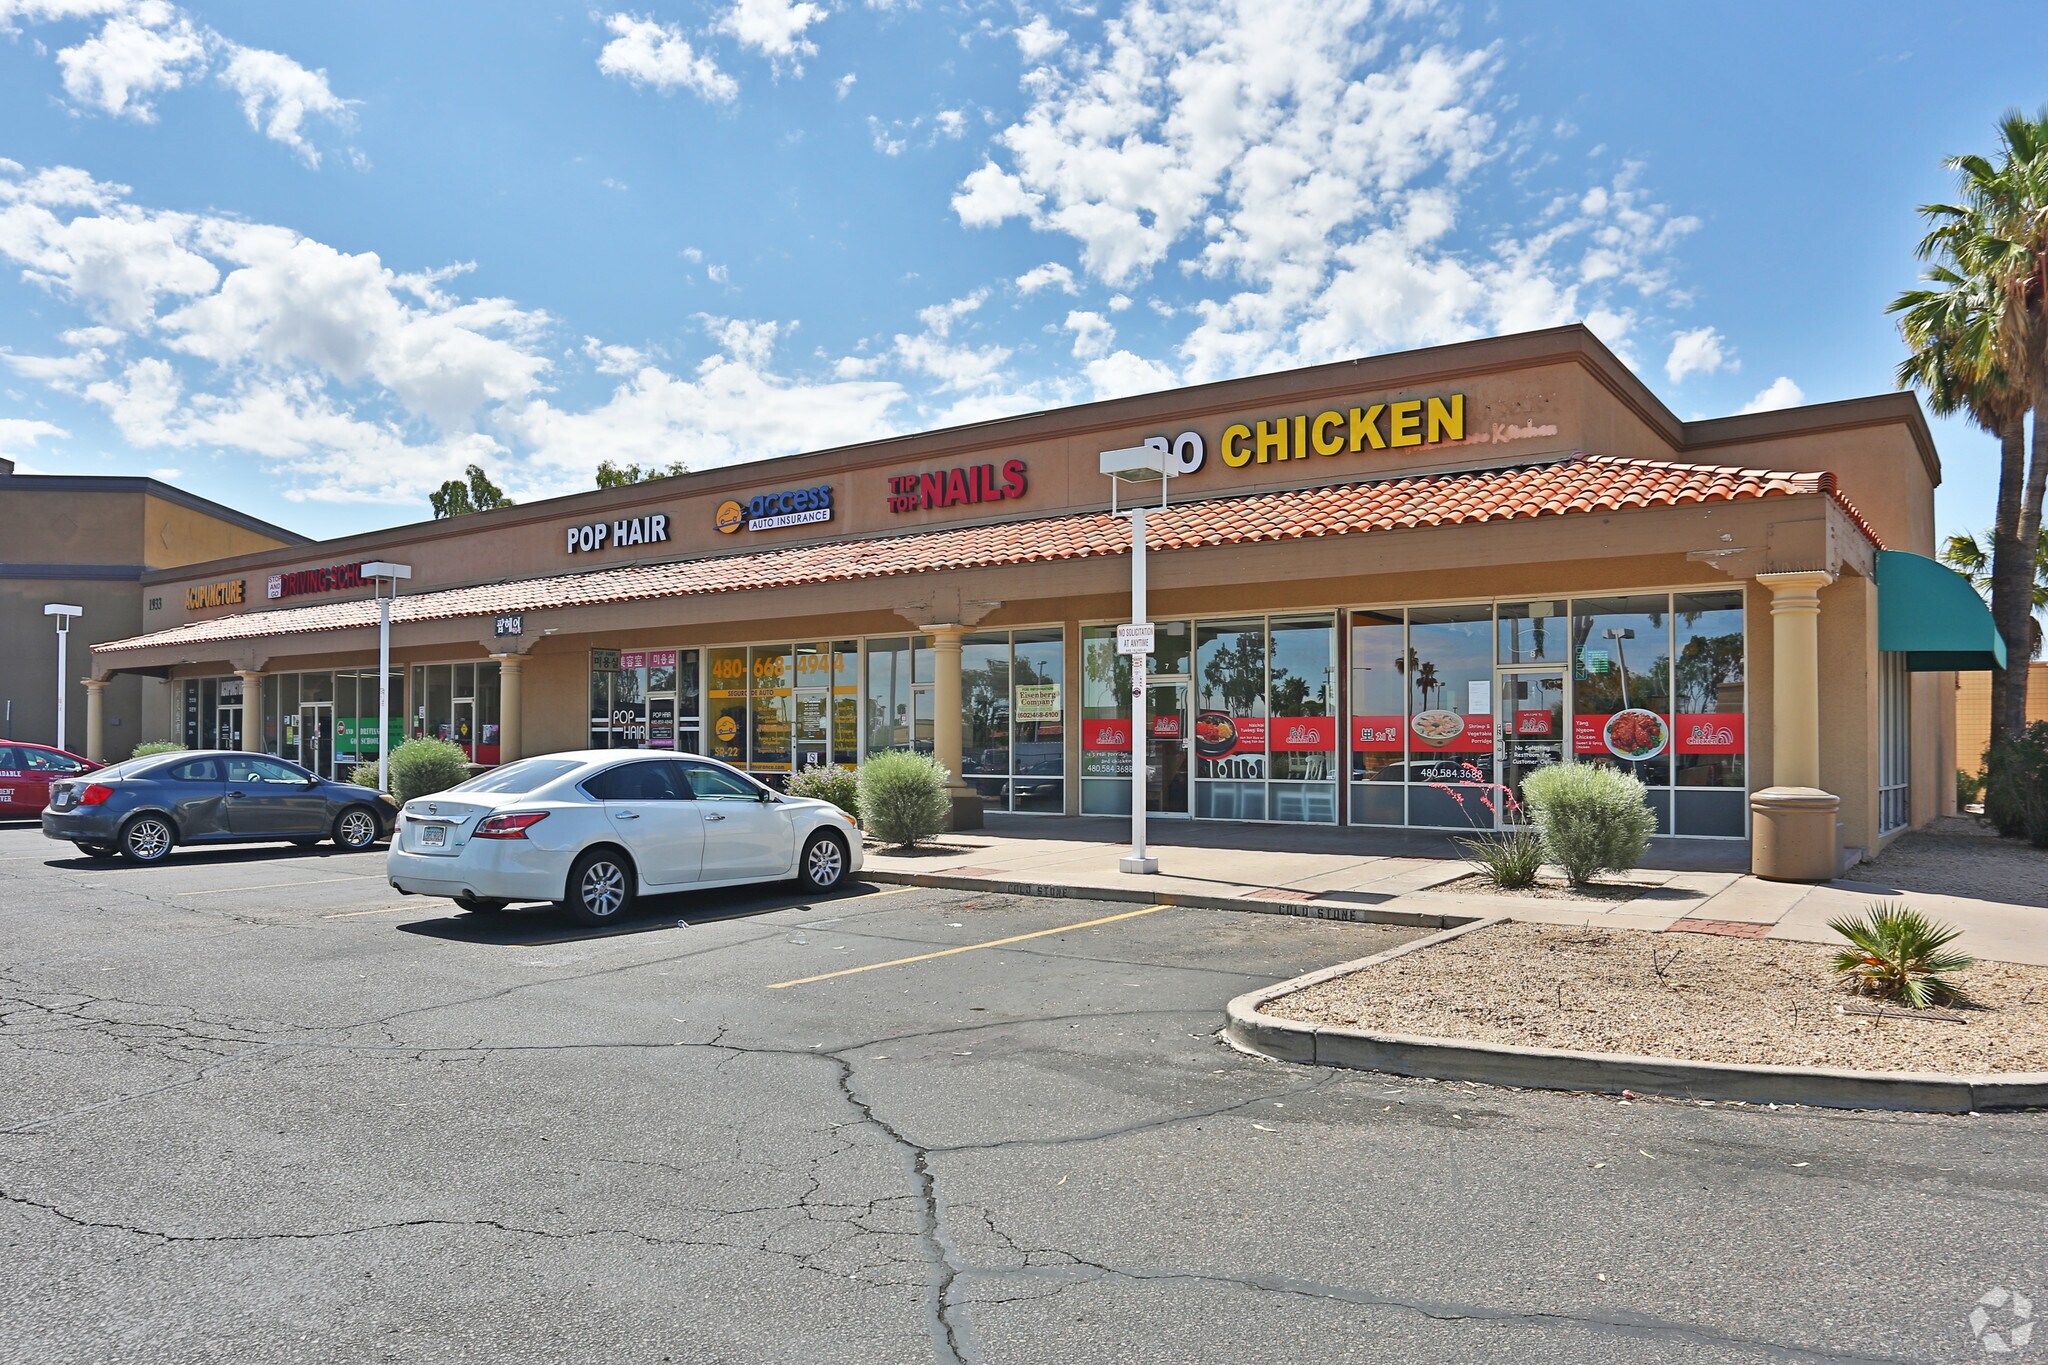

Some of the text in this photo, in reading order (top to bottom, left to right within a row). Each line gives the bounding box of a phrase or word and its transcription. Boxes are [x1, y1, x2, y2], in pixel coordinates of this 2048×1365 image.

[1221, 394, 1465, 468] CHICKEN
[888, 474, 919, 494] TIP
[920, 459, 1027, 509] NAILS
[750, 485, 833, 517] access
[887, 496, 918, 513] TOP
[752, 510, 828, 530] AUTO INSURANCE
[567, 514, 668, 554] POP HAIR
[281, 567, 328, 597] DRIVING
[185, 580, 243, 609] ACUPUNCTURE
[1119, 628, 1153, 637] NO SOLICITATION
[1124, 639, 1149, 647] AT ANYTIME
[1020, 691, 1056, 699] Eisenberg
[613, 710, 635, 724] POP
[623, 726, 645, 740] HAIR
[1421, 768, 1483, 778] 480.584.3688
[1317, 908, 1356, 921] STONE
